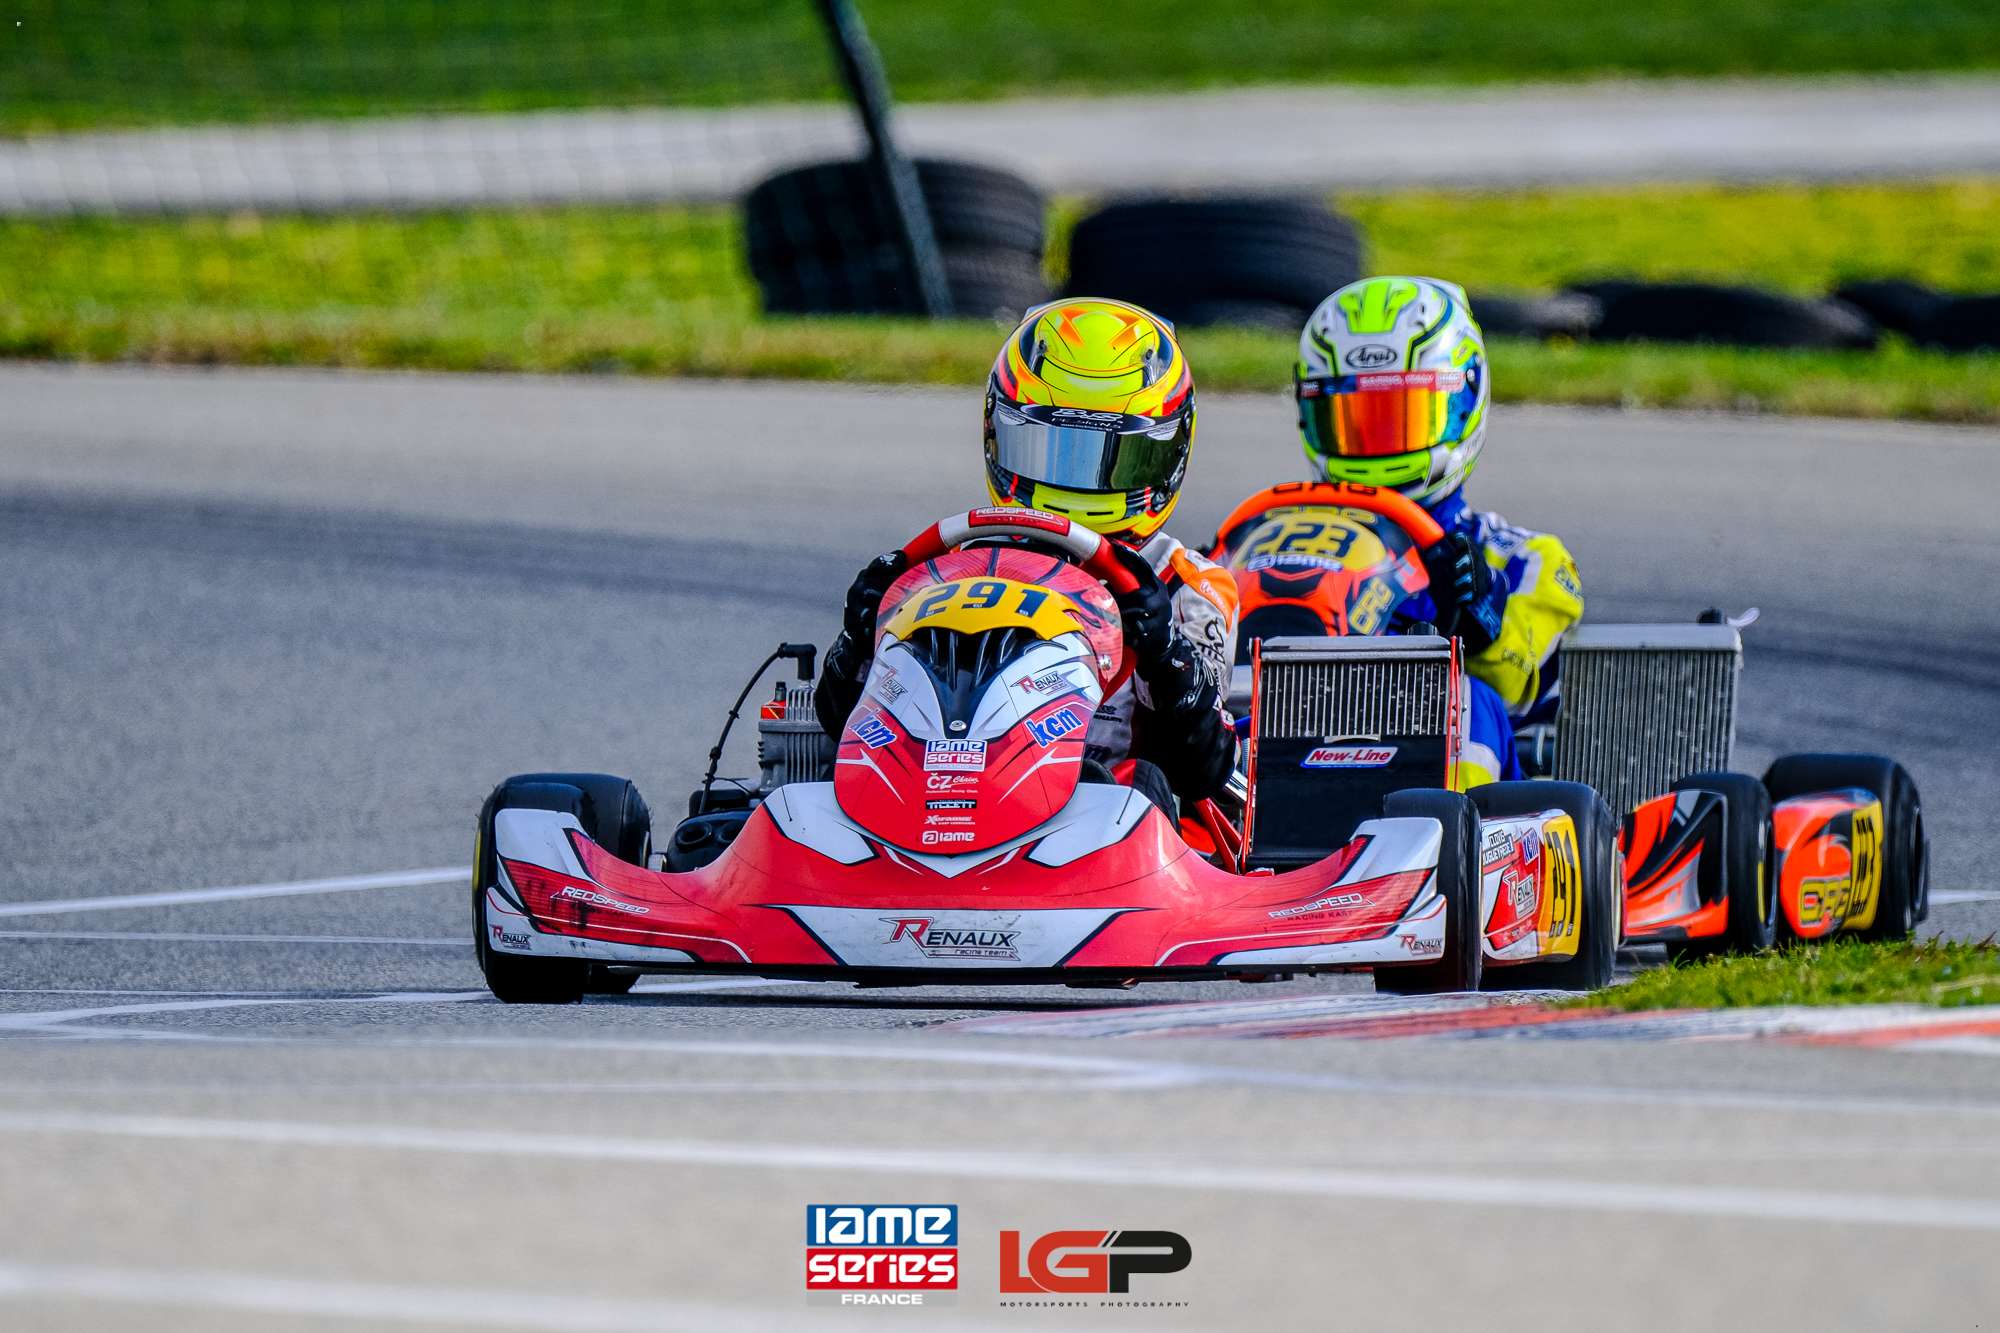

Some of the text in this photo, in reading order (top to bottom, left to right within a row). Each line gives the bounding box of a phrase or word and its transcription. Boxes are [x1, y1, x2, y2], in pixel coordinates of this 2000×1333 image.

[975, 507, 1054, 520] REDSPEED
[1245, 522, 1358, 562] 223
[913, 581, 1051, 623] 291
[1309, 749, 1392, 762] New-Line
[561, 885, 651, 915] REDSPEED
[1267, 892, 1363, 920] REDSPEED
[879, 916, 1016, 948] RENAUX
